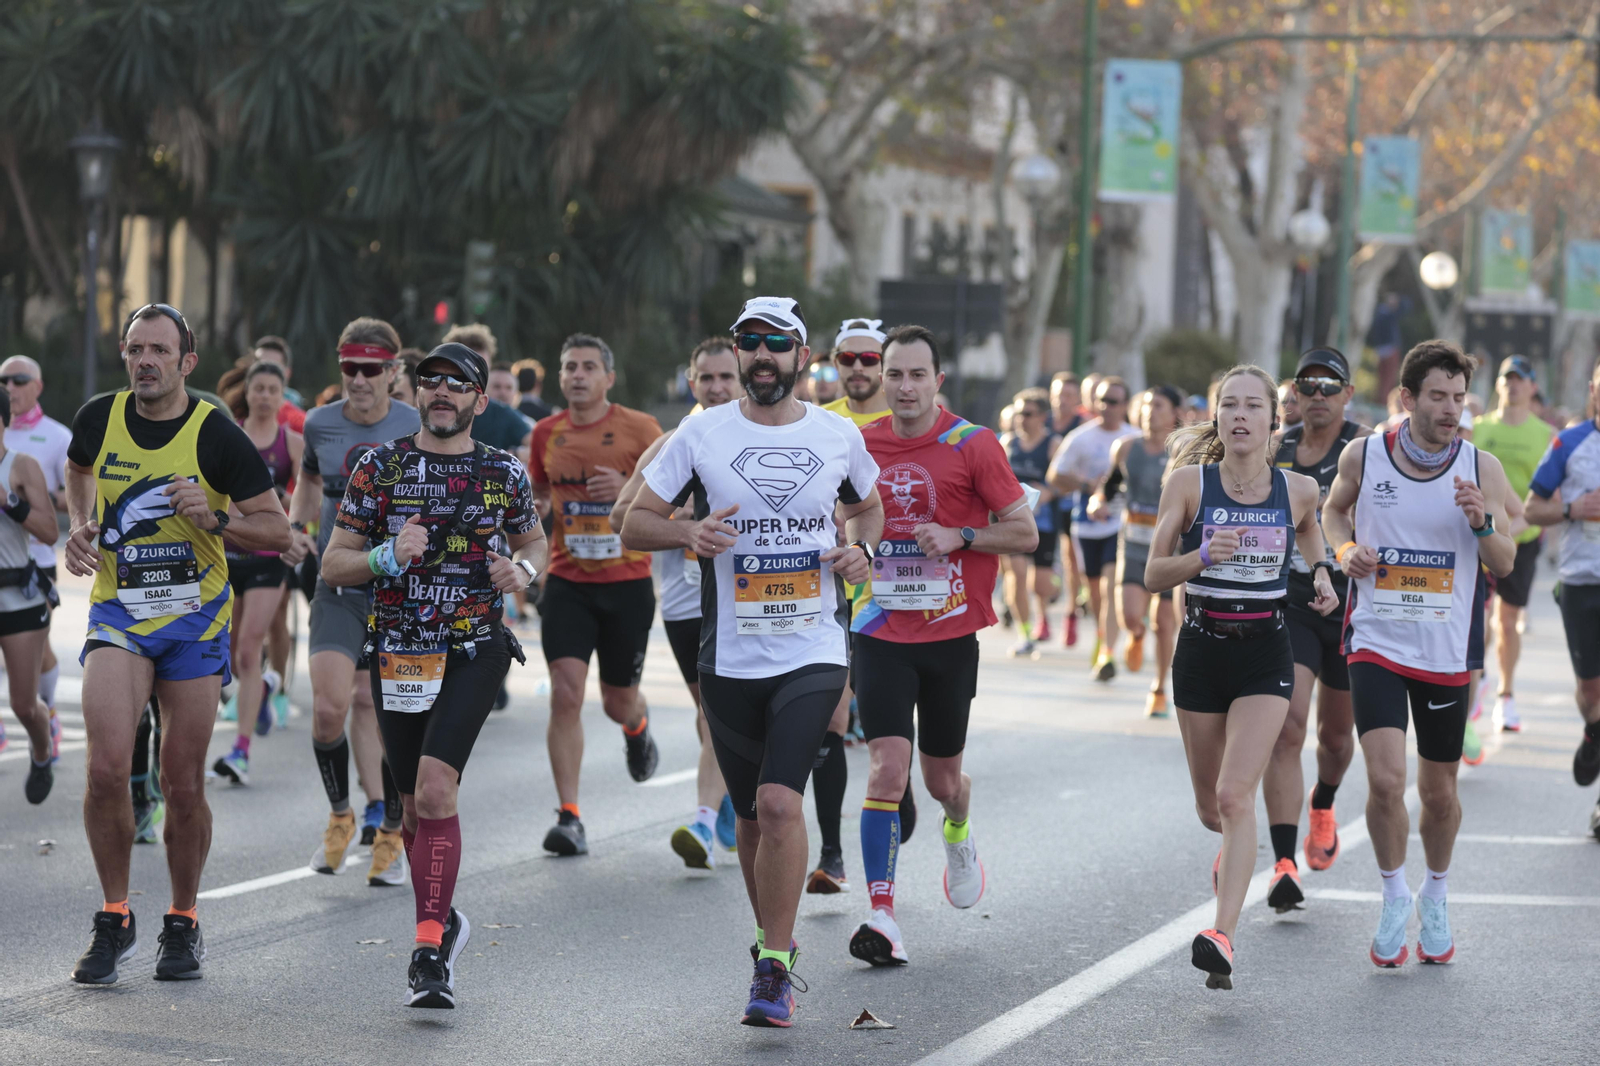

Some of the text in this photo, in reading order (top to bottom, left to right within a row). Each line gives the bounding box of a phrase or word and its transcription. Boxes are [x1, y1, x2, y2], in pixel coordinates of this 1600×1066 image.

[104, 452, 140, 471] Mercury
[98, 466, 131, 482] Runners
[428, 462, 472, 478] QUEEN
[447, 476, 482, 493] KINS
[787, 514, 827, 533] PAPÁ
[1231, 512, 1275, 523] ZURICH
[754, 533, 801, 547] de Caín
[140, 546, 186, 559] ZURICH
[895, 544, 923, 554] ZURI
[763, 556, 811, 570] ZURICH
[1250, 555, 1278, 564] BLAIKI
[1401, 553, 1446, 566] ZURICH
[142, 569, 171, 583] 3203
[896, 566, 922, 577] 5810
[432, 575, 447, 584] THE
[1400, 575, 1427, 588] 3486
[144, 589, 172, 600] ISAAC
[408, 574, 468, 606] BEATLES
[764, 582, 795, 596] 4735
[892, 584, 926, 593] JUANJO
[1401, 593, 1424, 604] VEGA
[763, 603, 797, 614] BELITO
[395, 663, 423, 677] 4202
